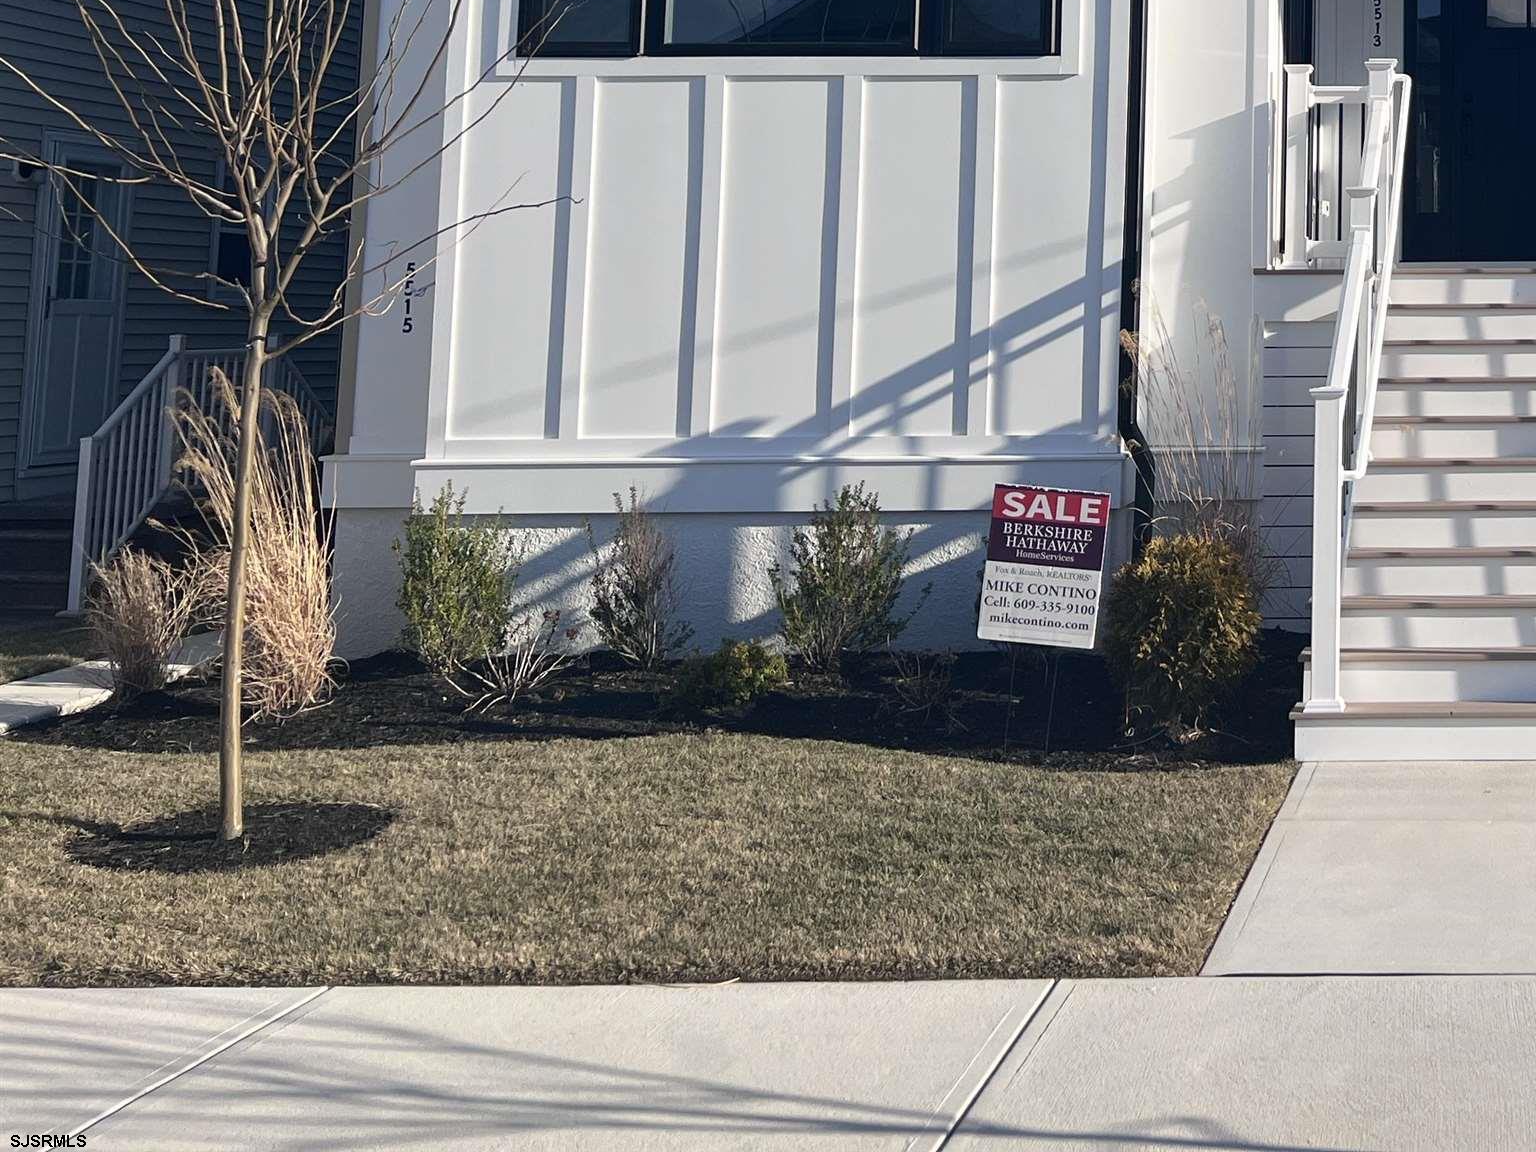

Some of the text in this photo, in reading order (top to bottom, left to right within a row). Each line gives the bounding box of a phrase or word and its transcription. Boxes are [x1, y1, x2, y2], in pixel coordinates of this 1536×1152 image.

[1002, 492, 1102, 524] SALE
[1002, 522, 1093, 542] BERKSHIRE
[1005, 536, 1088, 554] HATHAWAY
[1016, 549, 1074, 562] HomeServices
[995, 566, 1009, 574] Fox
[986, 580, 1096, 600] MIKE CONTINO
[984, 596, 1096, 616] Cell: 609-335-9100
[989, 613, 1089, 630] mikecontino.com
